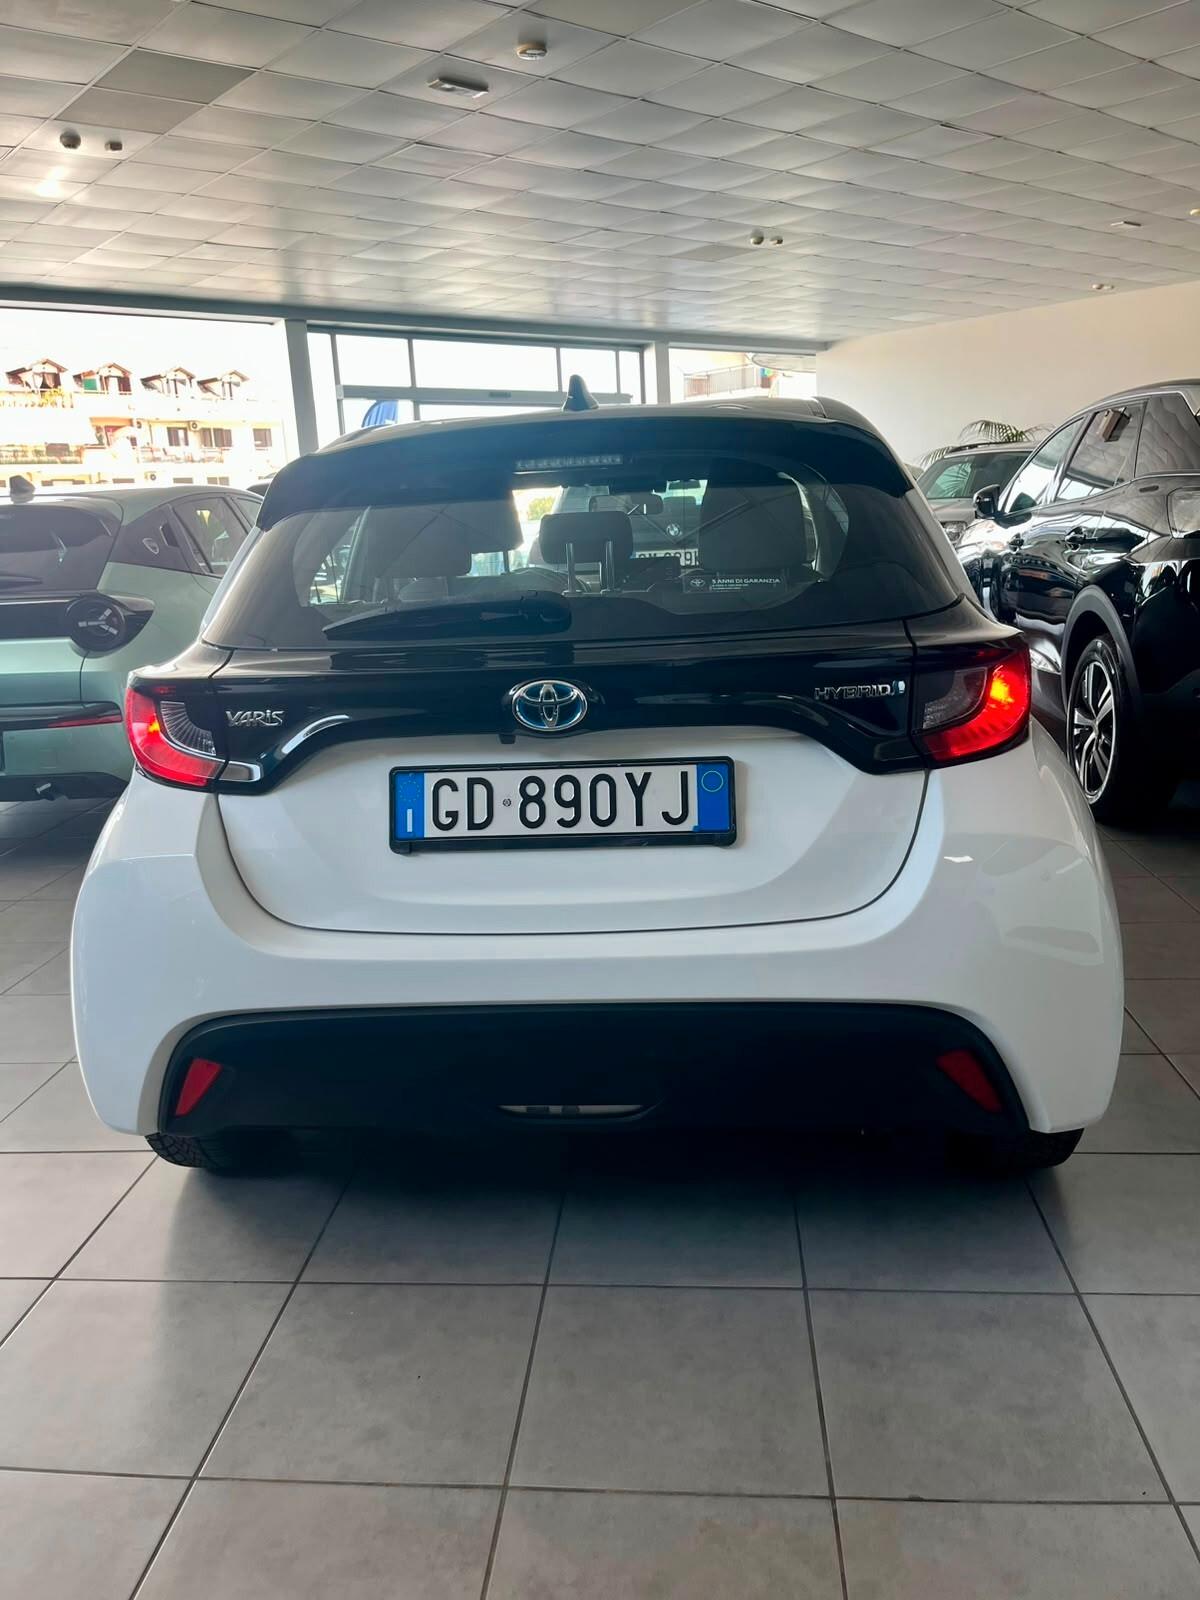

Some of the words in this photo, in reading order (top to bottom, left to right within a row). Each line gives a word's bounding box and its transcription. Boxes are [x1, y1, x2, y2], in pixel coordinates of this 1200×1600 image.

[814, 684, 891, 700] HYBRID
[431, 777, 494, 832] GD
[517, 770, 690, 830] 890YJ
